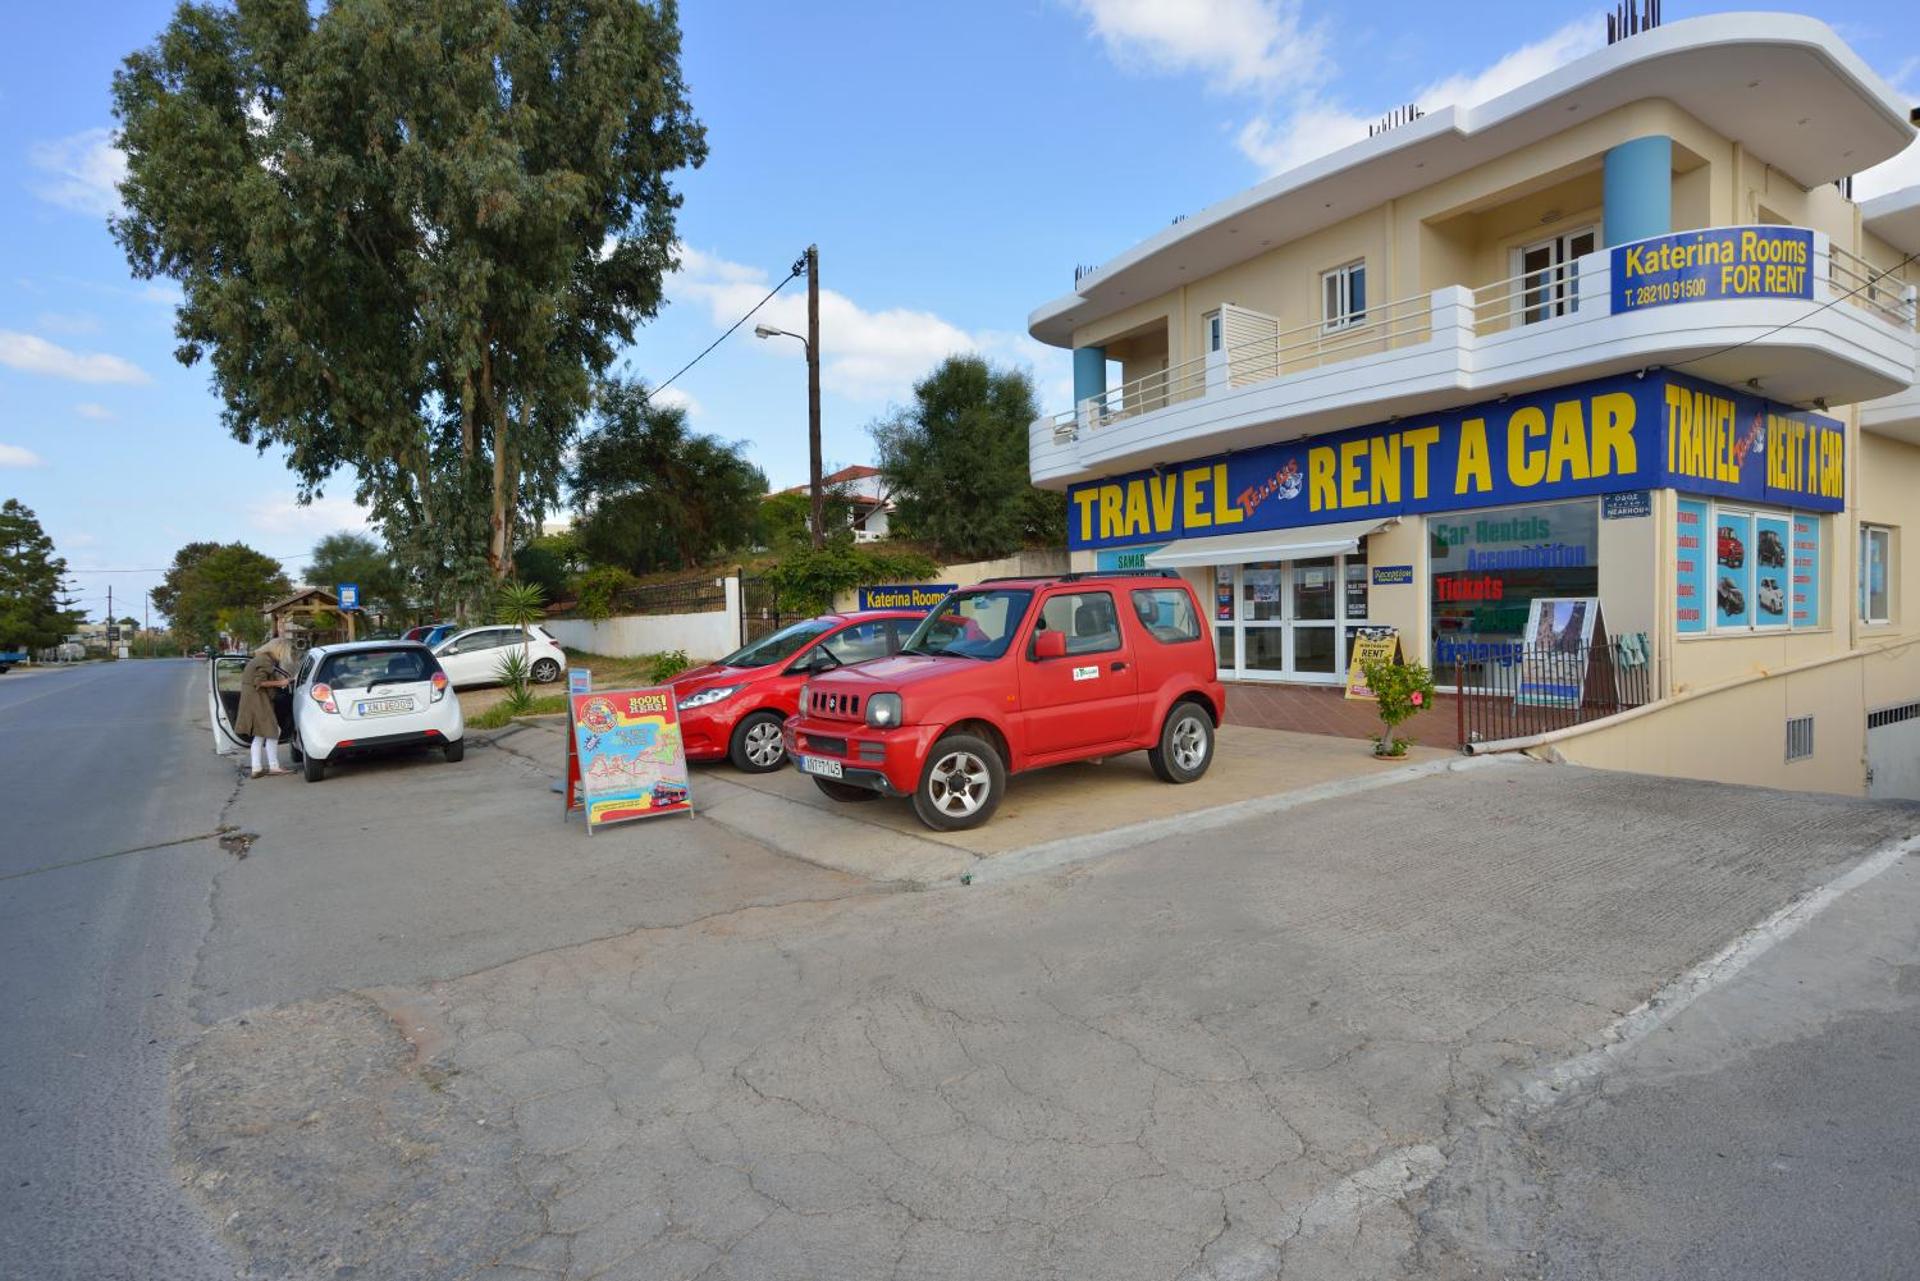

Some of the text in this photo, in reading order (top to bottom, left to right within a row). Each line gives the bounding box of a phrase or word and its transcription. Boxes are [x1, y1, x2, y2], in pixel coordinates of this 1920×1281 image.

[1625, 230, 1807, 278] Katerina Rooms
[1637, 286, 1670, 304] 28210
[1672, 278, 1706, 298] 91500
[1720, 264, 1807, 295] FOR RENT
[1665, 383, 1740, 484] TRAVEL
[1767, 413, 1806, 493] RENT
[1808, 422, 1818, 495] A
[1820, 426, 1844, 500] CAR
[1073, 463, 1244, 542] TRAVEL
[1308, 425, 1440, 513] RENT
[1454, 418, 1494, 494] A
[1507, 392, 1639, 488] CAR
[1436, 516, 1550, 548] Car Rentals
[866, 590, 911, 608] Katerina
[1436, 575, 1503, 600] Tickets
[1361, 649, 1385, 658] RENT
